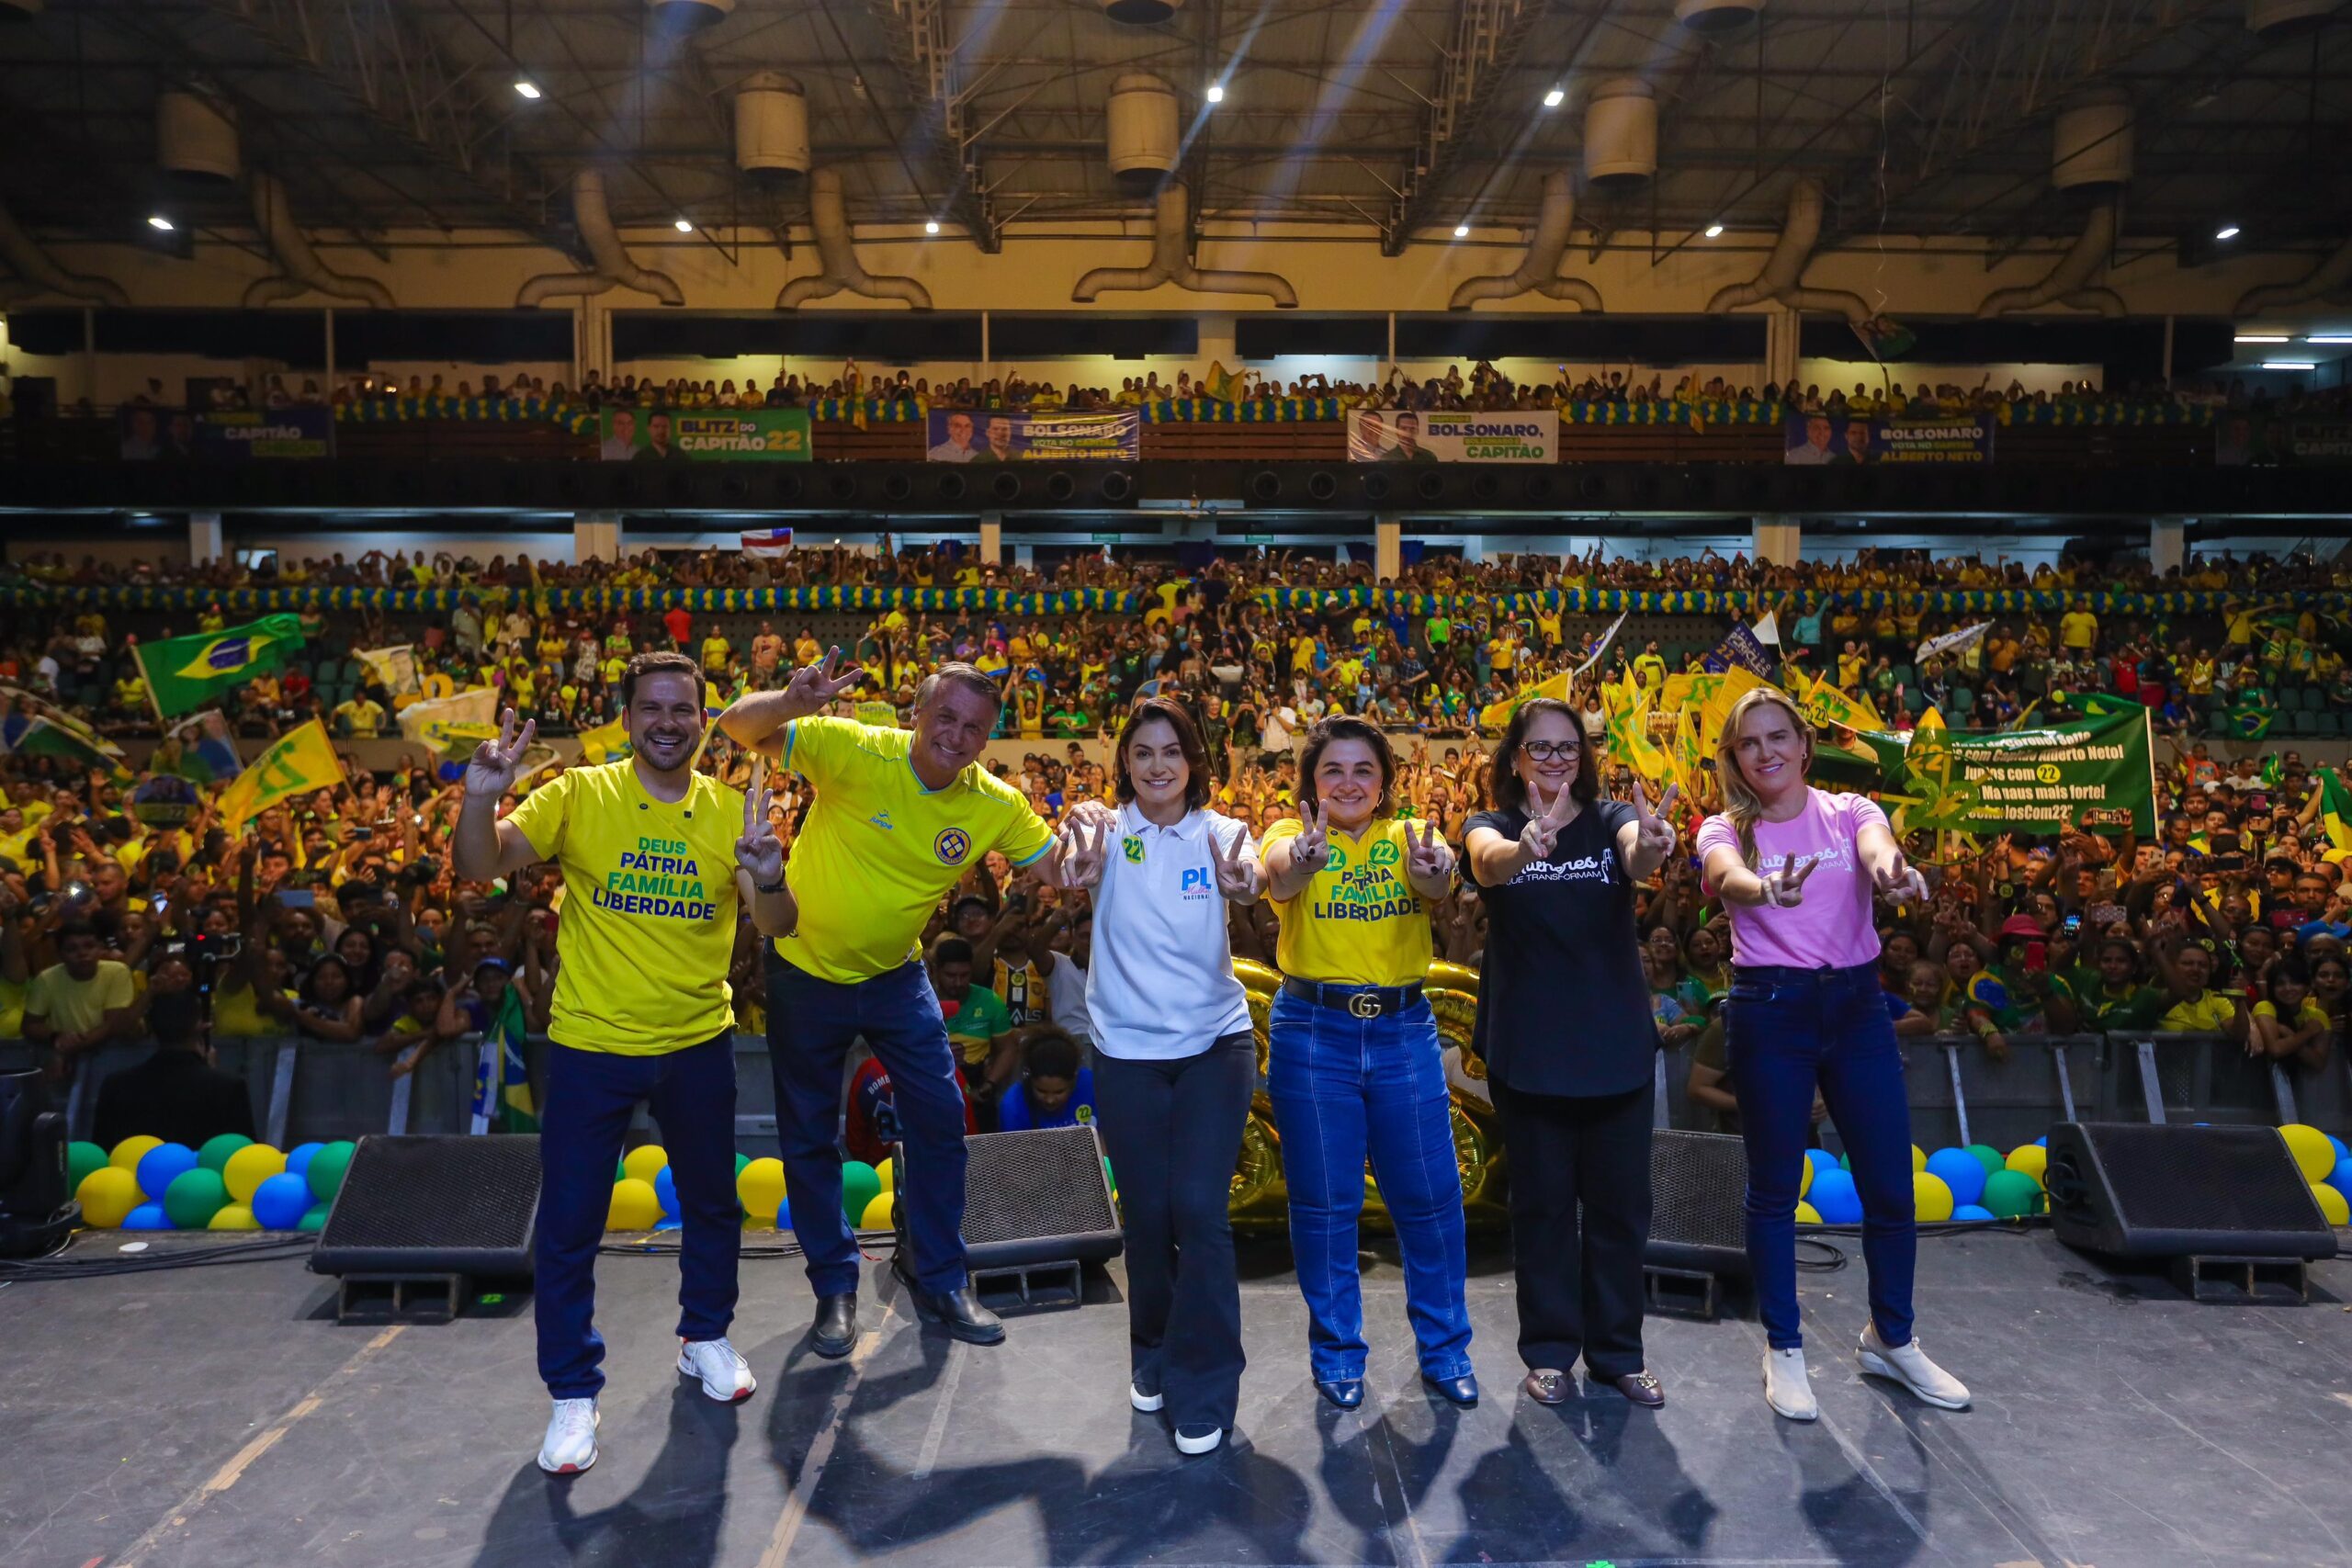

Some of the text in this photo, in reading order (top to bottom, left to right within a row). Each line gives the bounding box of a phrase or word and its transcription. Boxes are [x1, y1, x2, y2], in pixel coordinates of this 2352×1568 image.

[224, 425, 302, 440] CAPITÃO
[681, 420, 756, 433] BLITZ DO
[1023, 424, 1127, 437] BOLSONARO
[1428, 424, 1544, 438] BOLSONARO,
[1881, 426, 1984, 441] BOLSONARO
[680, 430, 801, 451] CAPITÃO 22
[1032, 439, 1057, 447] VOTA
[1059, 439, 1073, 447] NO
[1891, 441, 1916, 449] VOTA
[1917, 441, 1932, 449] NO
[1023, 449, 1129, 460] ALBERTO NETO
[1466, 444, 1544, 458] CAPITÃO
[1882, 450, 1984, 462] ALBERTO NETO
[1715, 643, 1736, 660] 22
[1912, 742, 1944, 772] 22
[2087, 744, 2124, 761] Neto!
[2007, 767, 2036, 781] com
[2040, 767, 2057, 780] 22
[2034, 785, 2068, 800] mais
[2069, 784, 2107, 800] forte!
[638, 836, 687, 856] DEUS
[1124, 838, 1143, 862] 22
[1374, 842, 1395, 863] 22
[620, 851, 699, 876] PÁTRIA
[1521, 856, 1599, 874] ulheres
[1182, 867, 1212, 891] PL
[1526, 870, 1602, 882] TRANSFORMAM
[607, 872, 705, 900] FAMÍLIA
[1330, 882, 1408, 905] FAMÍLIA
[593, 887, 717, 921] LIBERDADE
[1315, 897, 1422, 922] LIBERDADE
